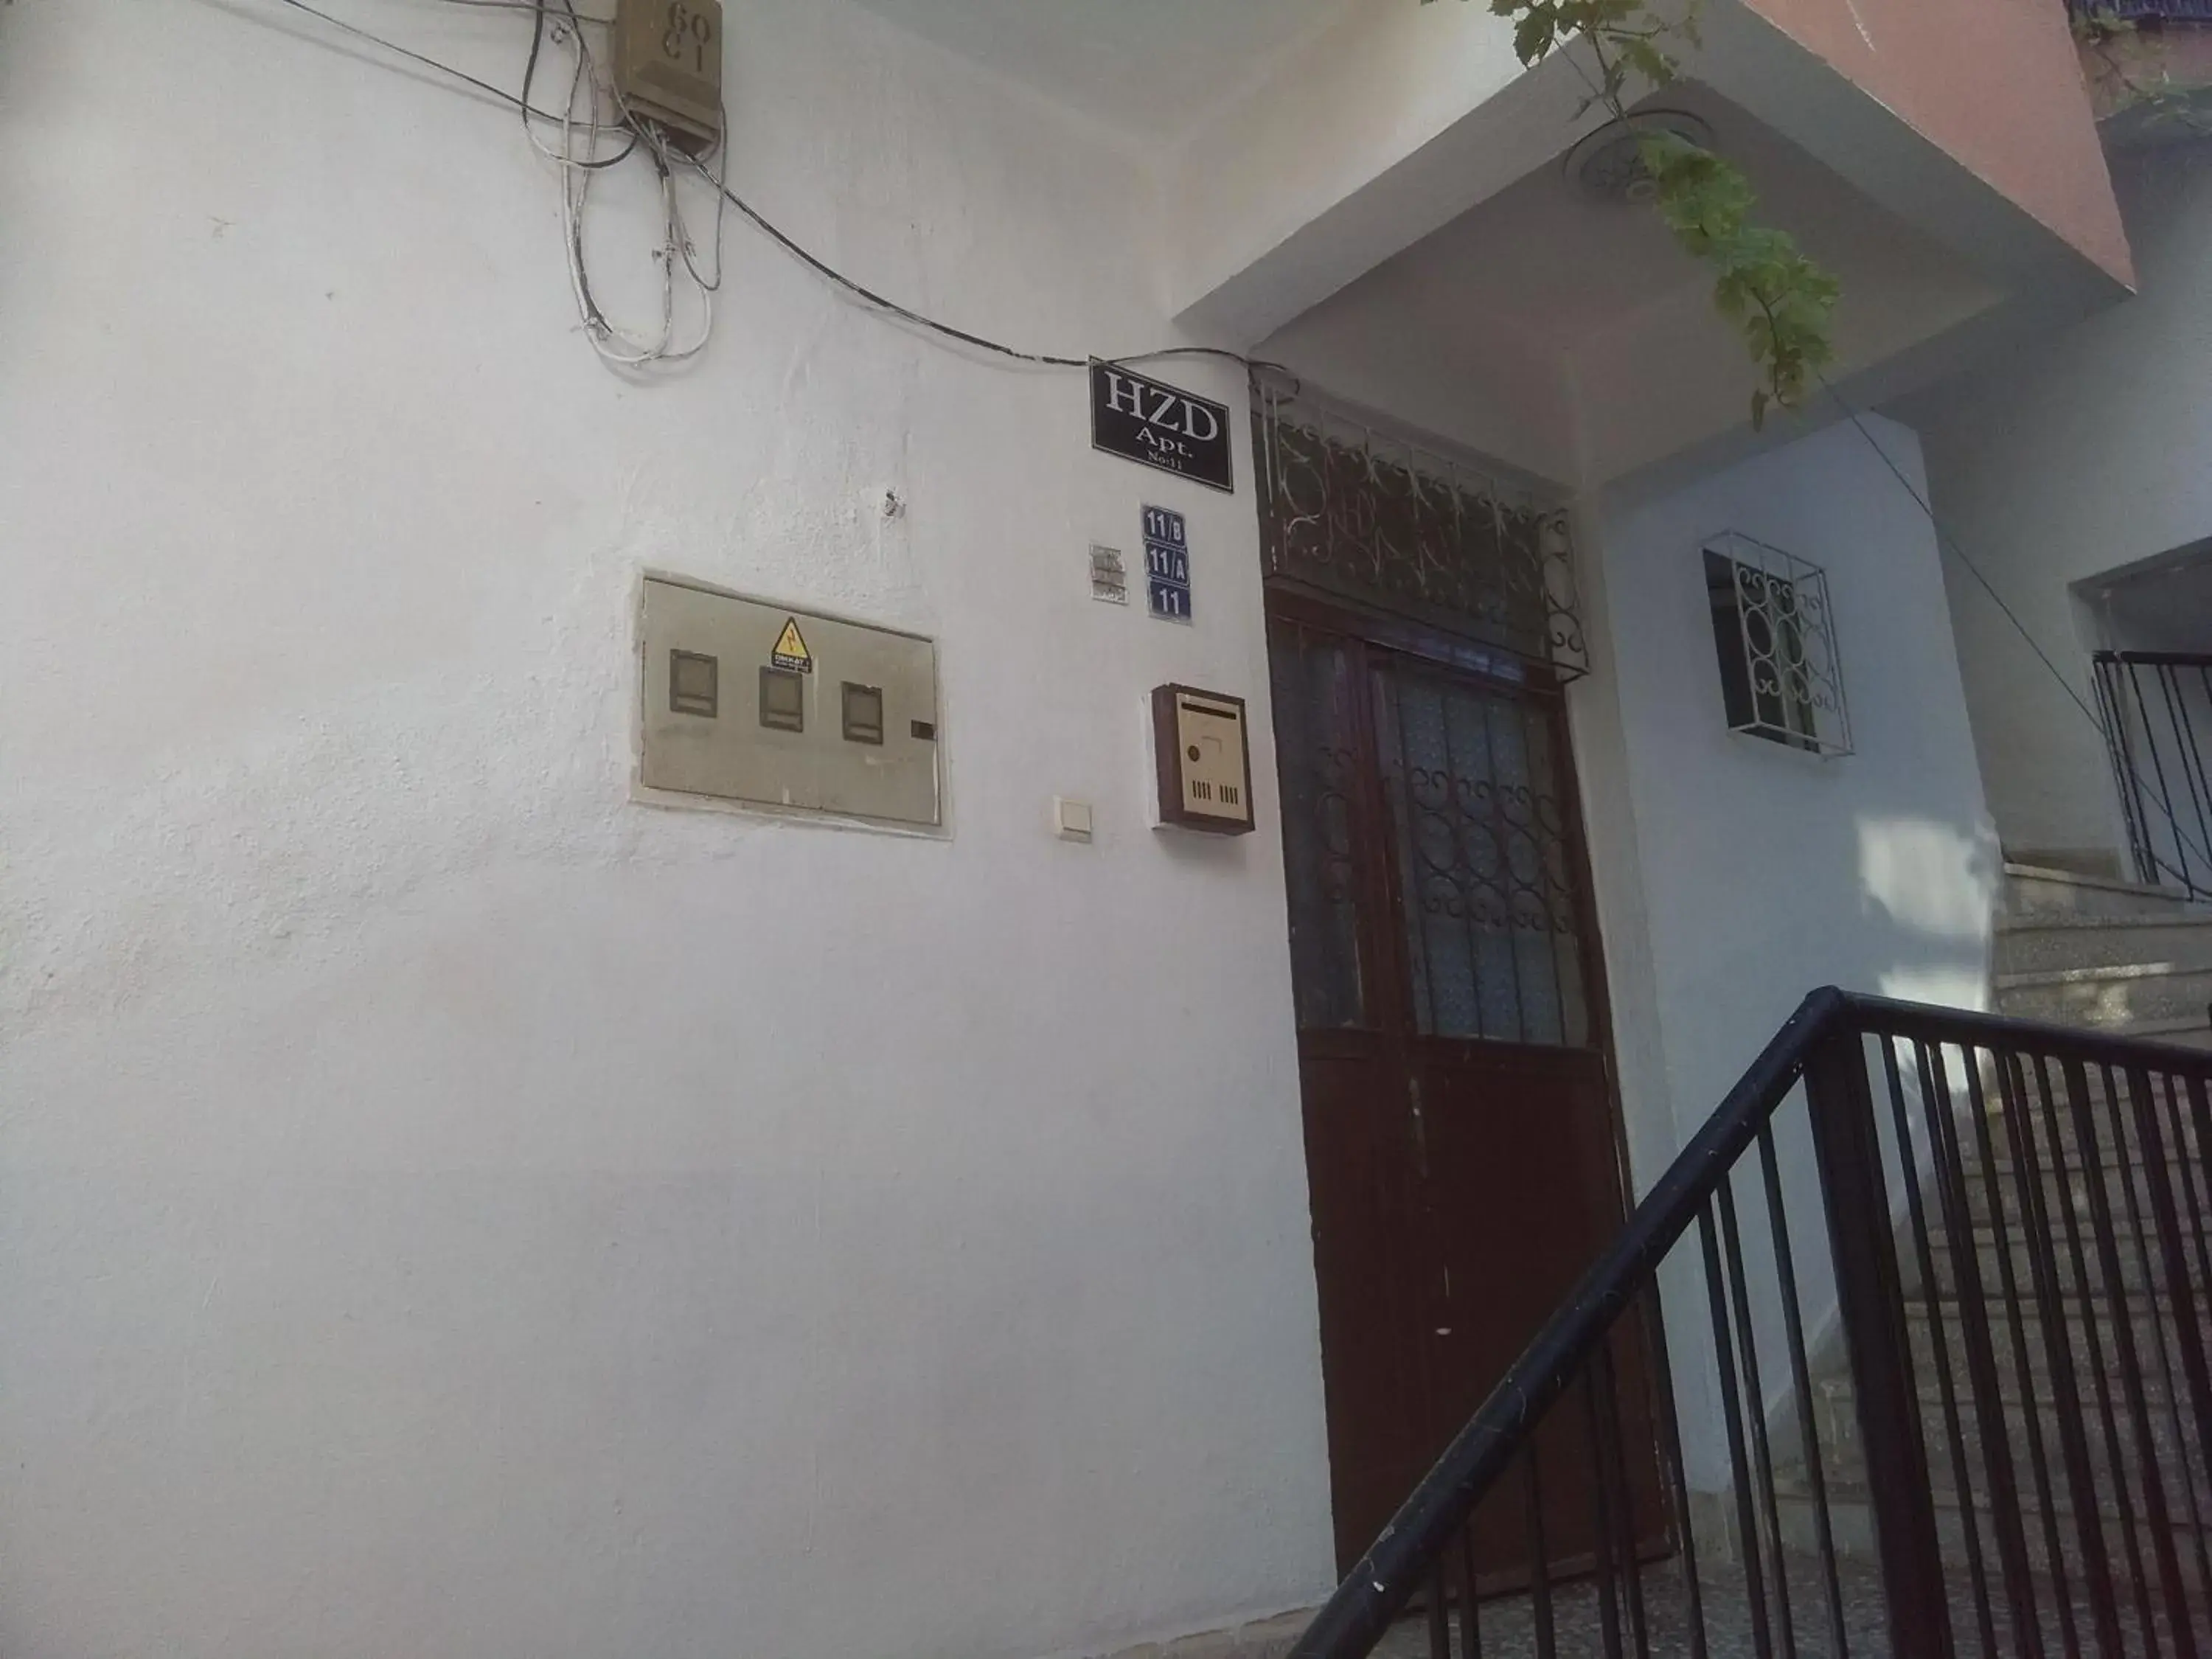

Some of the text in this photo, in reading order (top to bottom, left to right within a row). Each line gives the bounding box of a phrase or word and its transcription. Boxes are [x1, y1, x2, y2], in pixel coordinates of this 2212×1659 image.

[1105, 371, 1219, 441] HZD
[1135, 427, 1192, 458] Apt.
[1147, 510, 1181, 540] 11/B
[1150, 549, 1185, 580] 11/A
[1160, 588, 1180, 614] 11
